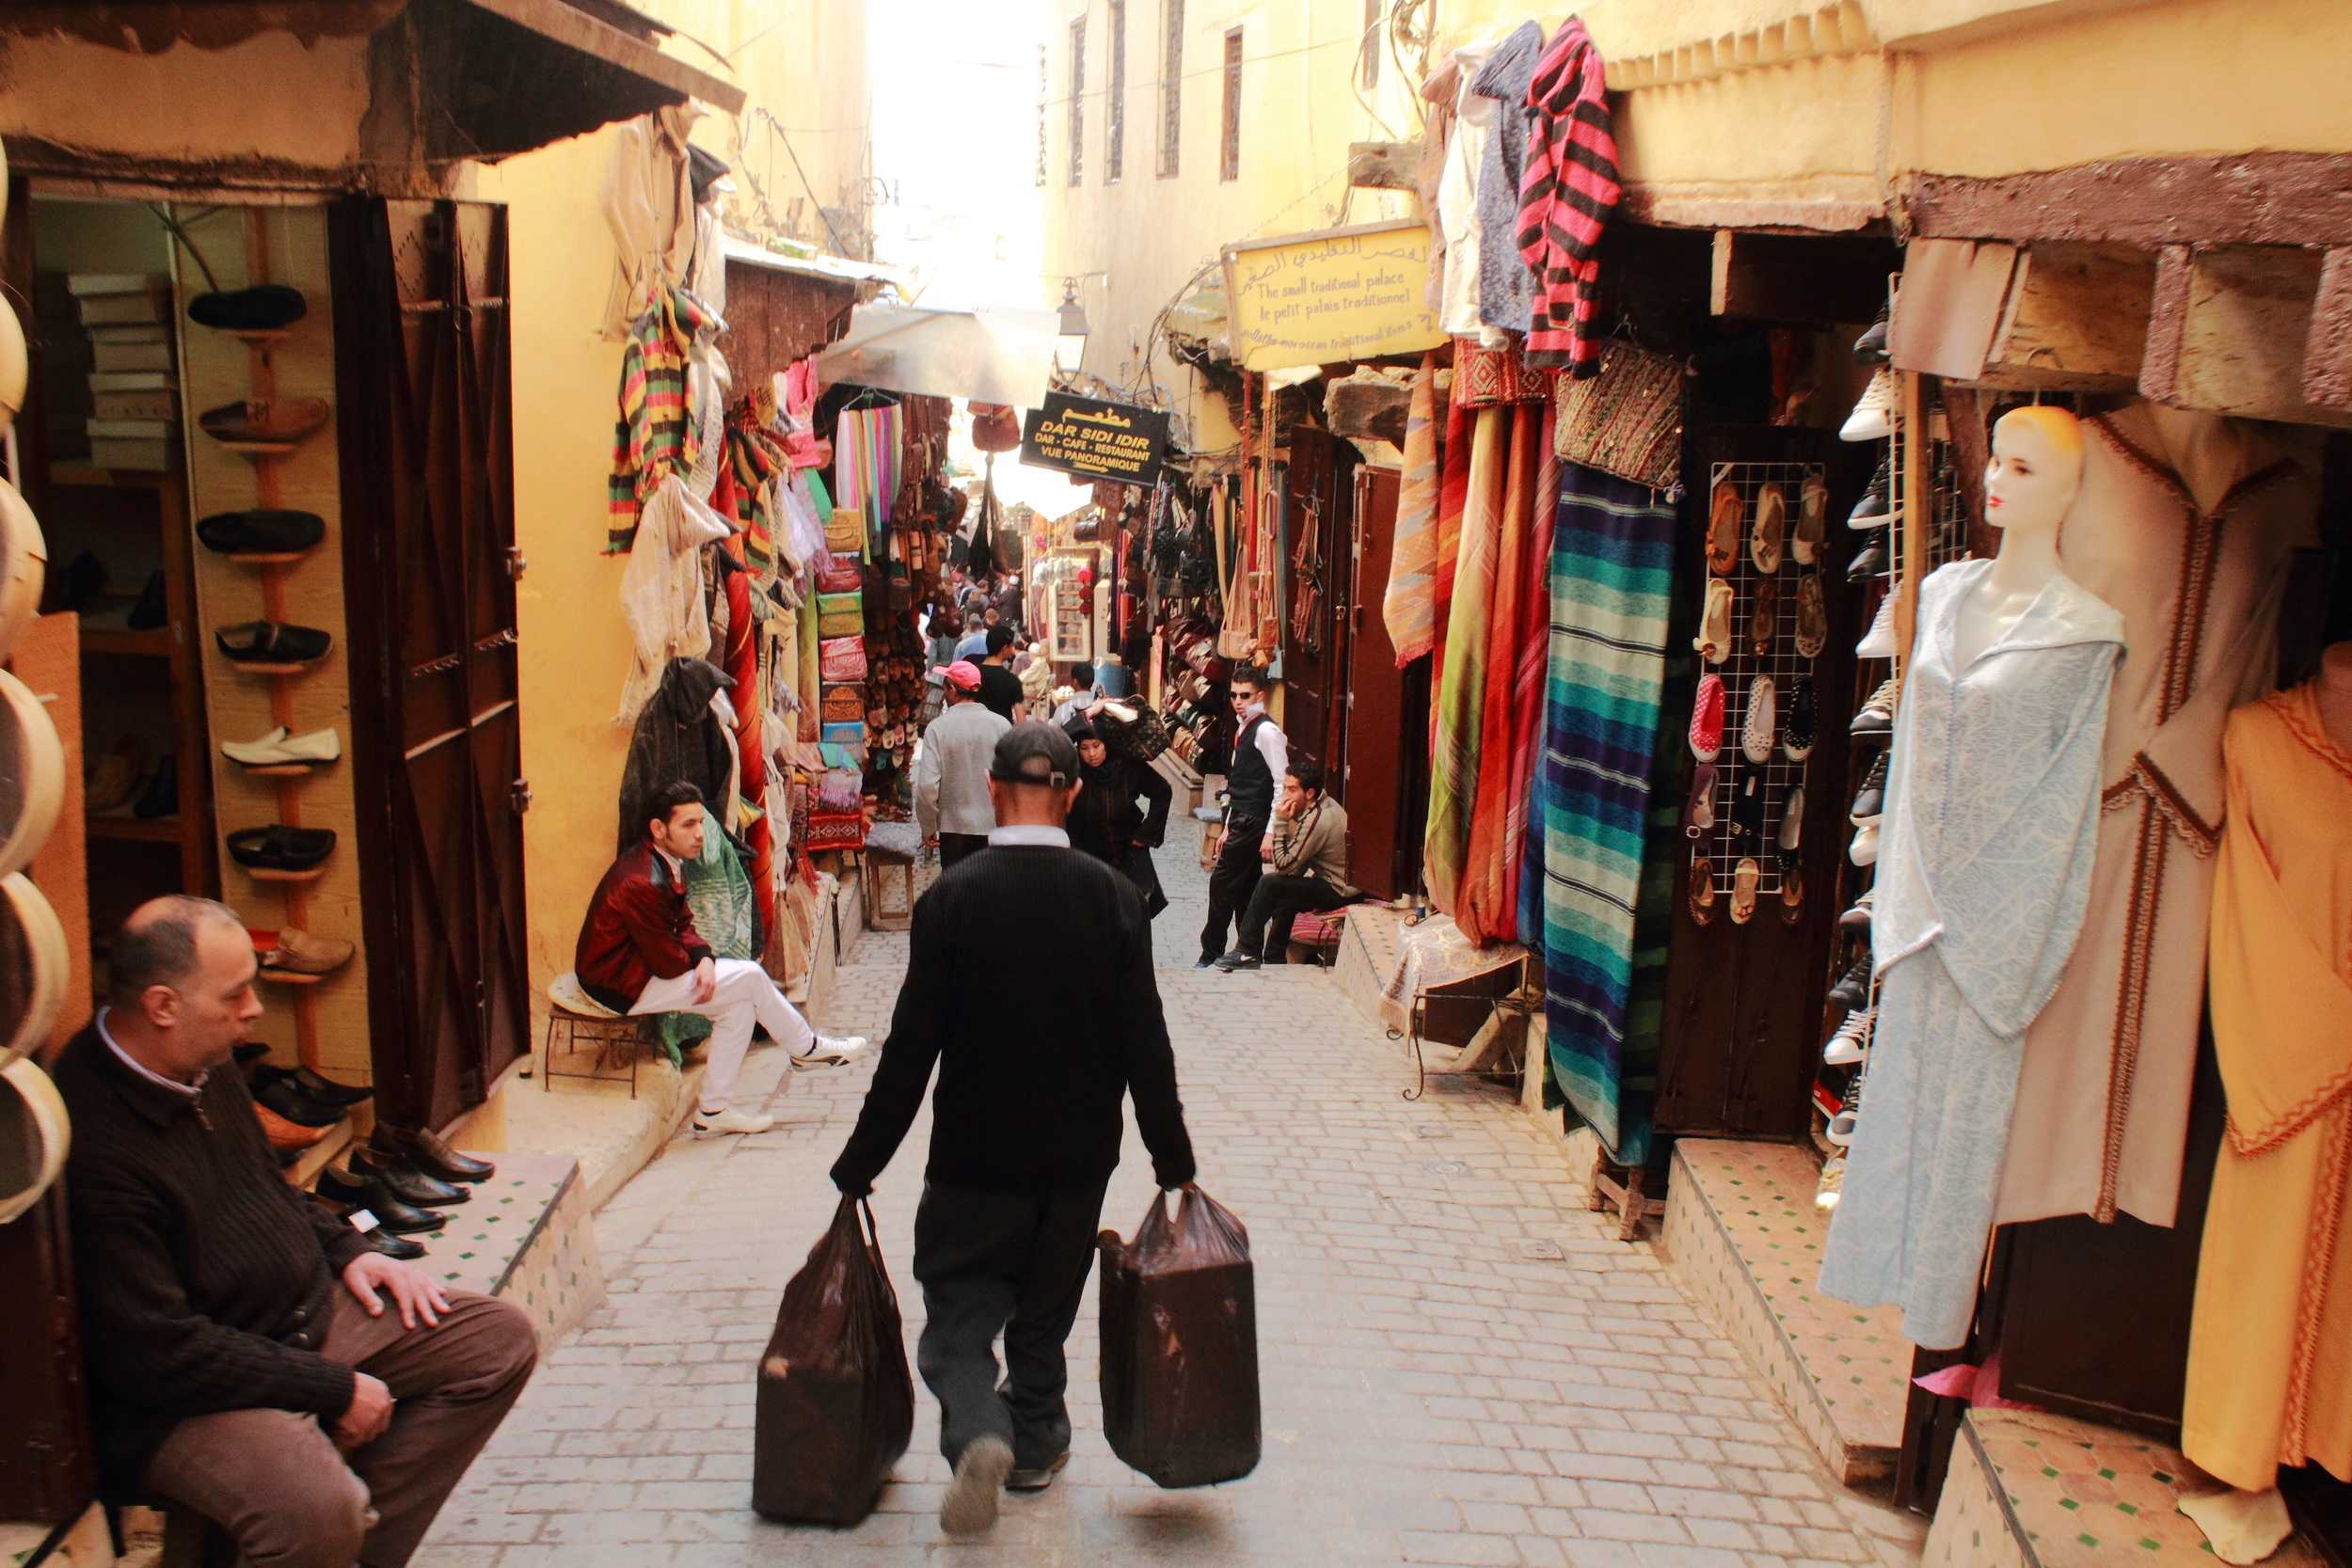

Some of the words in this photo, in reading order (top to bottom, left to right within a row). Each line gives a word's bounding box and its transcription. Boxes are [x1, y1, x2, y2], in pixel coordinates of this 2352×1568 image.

[1361, 245, 1430, 263] لقصر
[1257, 283, 1279, 299] The
[1281, 277, 1307, 297] small
[1311, 271, 1360, 293] traditional
[1366, 267, 1405, 292] palace
[1260, 306, 1270, 321] le
[1274, 303, 1300, 325] petit
[1306, 298, 1340, 321] palais
[1343, 288, 1410, 309] traditionnel
[1279, 339, 1327, 350] moroccan
[1330, 327, 1383, 349] traditional
[1061, 406, 1131, 429] مطعم
[1035, 432, 1056, 445] DAR
[1062, 437, 1088, 451] CAFE
[1094, 442, 1152, 462] RESTAURANT
[1040, 420, 1078, 438] DAR
[1080, 427, 1114, 444] SIDI
[1115, 434, 1150, 451] IDIR
[1041, 445, 1063, 459] VUE
[1064, 449, 1141, 473] PANORAMIQUE
